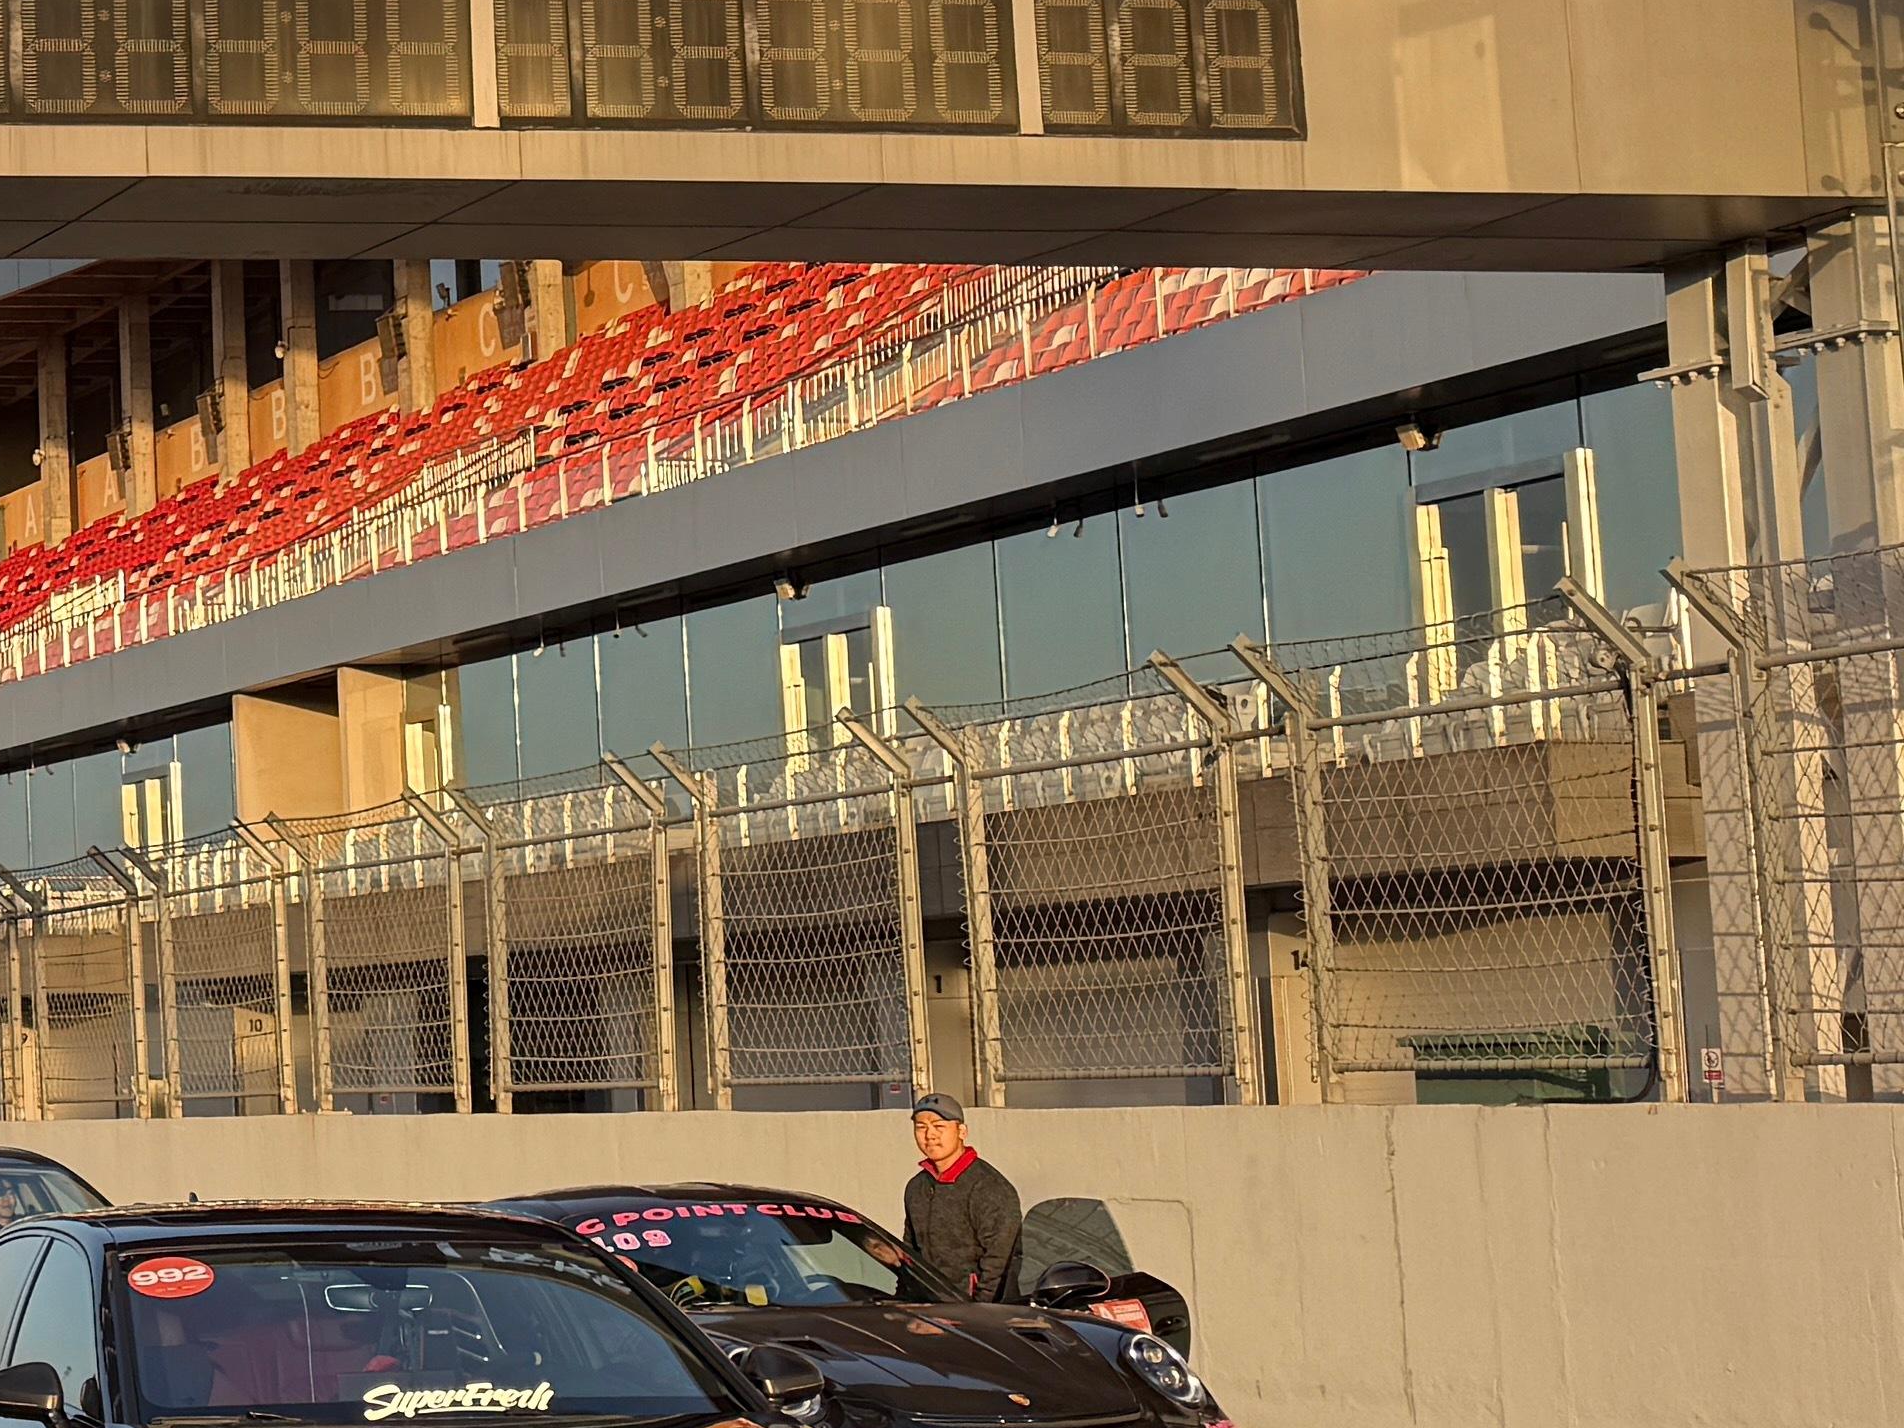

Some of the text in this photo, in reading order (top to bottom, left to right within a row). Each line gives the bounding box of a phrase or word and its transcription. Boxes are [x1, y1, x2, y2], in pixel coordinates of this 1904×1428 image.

[359, 351, 377, 406] B
[270, 388, 286, 441] B
[24, 494, 39, 539] A
[249, 1018, 263, 1032] 10
[612, 1203, 748, 1226] POINT
[756, 1204, 862, 1224] CLUB
[131, 1265, 210, 1286] 992
